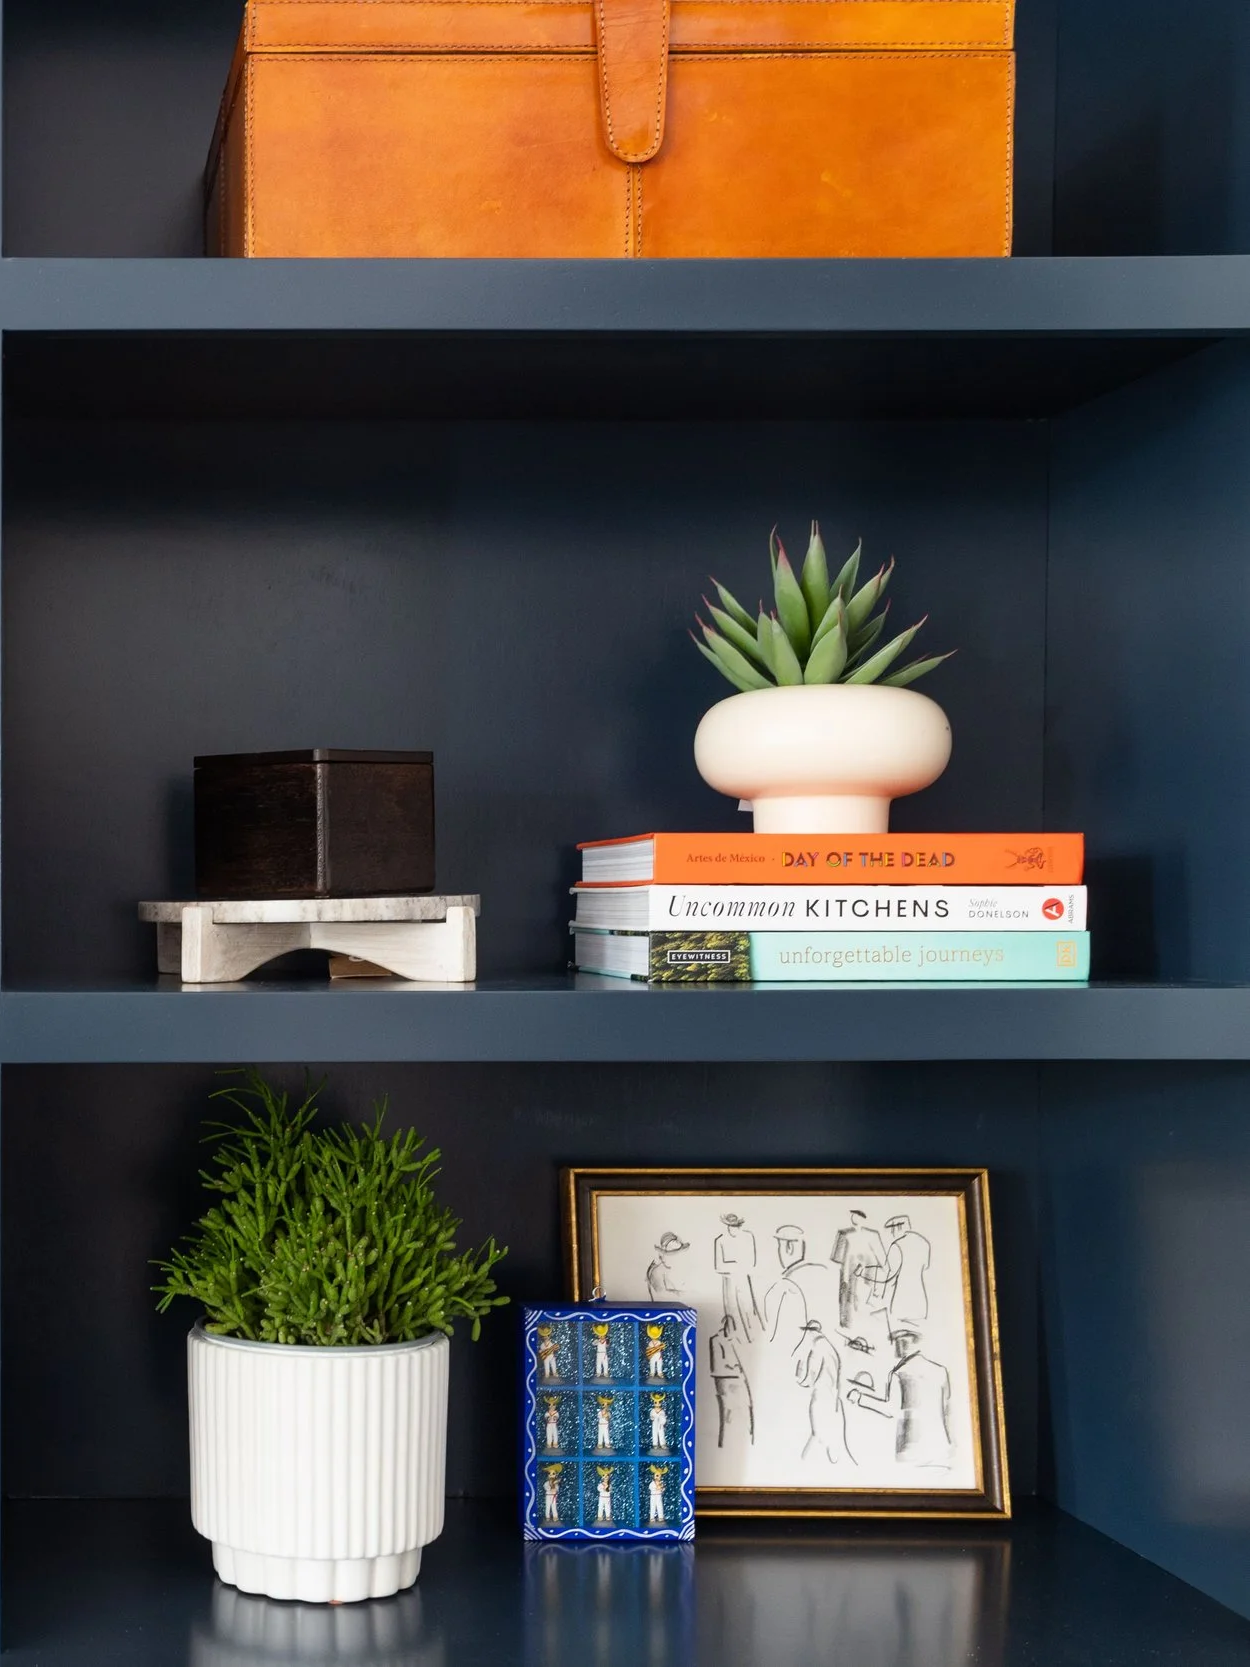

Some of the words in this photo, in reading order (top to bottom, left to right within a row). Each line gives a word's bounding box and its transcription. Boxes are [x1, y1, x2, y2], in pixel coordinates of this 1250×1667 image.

[686, 853, 713, 863] Artes
[715, 852, 727, 863] de
[729, 852, 766, 863] México
[781, 851, 820, 868] DAY
[825, 851, 853, 868] OF
[859, 851, 894, 868] THE
[902, 851, 956, 868] DEAD
[668, 895, 796, 918] Uncommon
[805, 898, 950, 919] KITCHENS
[968, 910, 1029, 919] DONELSON
[671, 952, 727, 961] EYEWITNESS
[779, 945, 912, 968] unforgettable
[917, 945, 1004, 967] journeys
